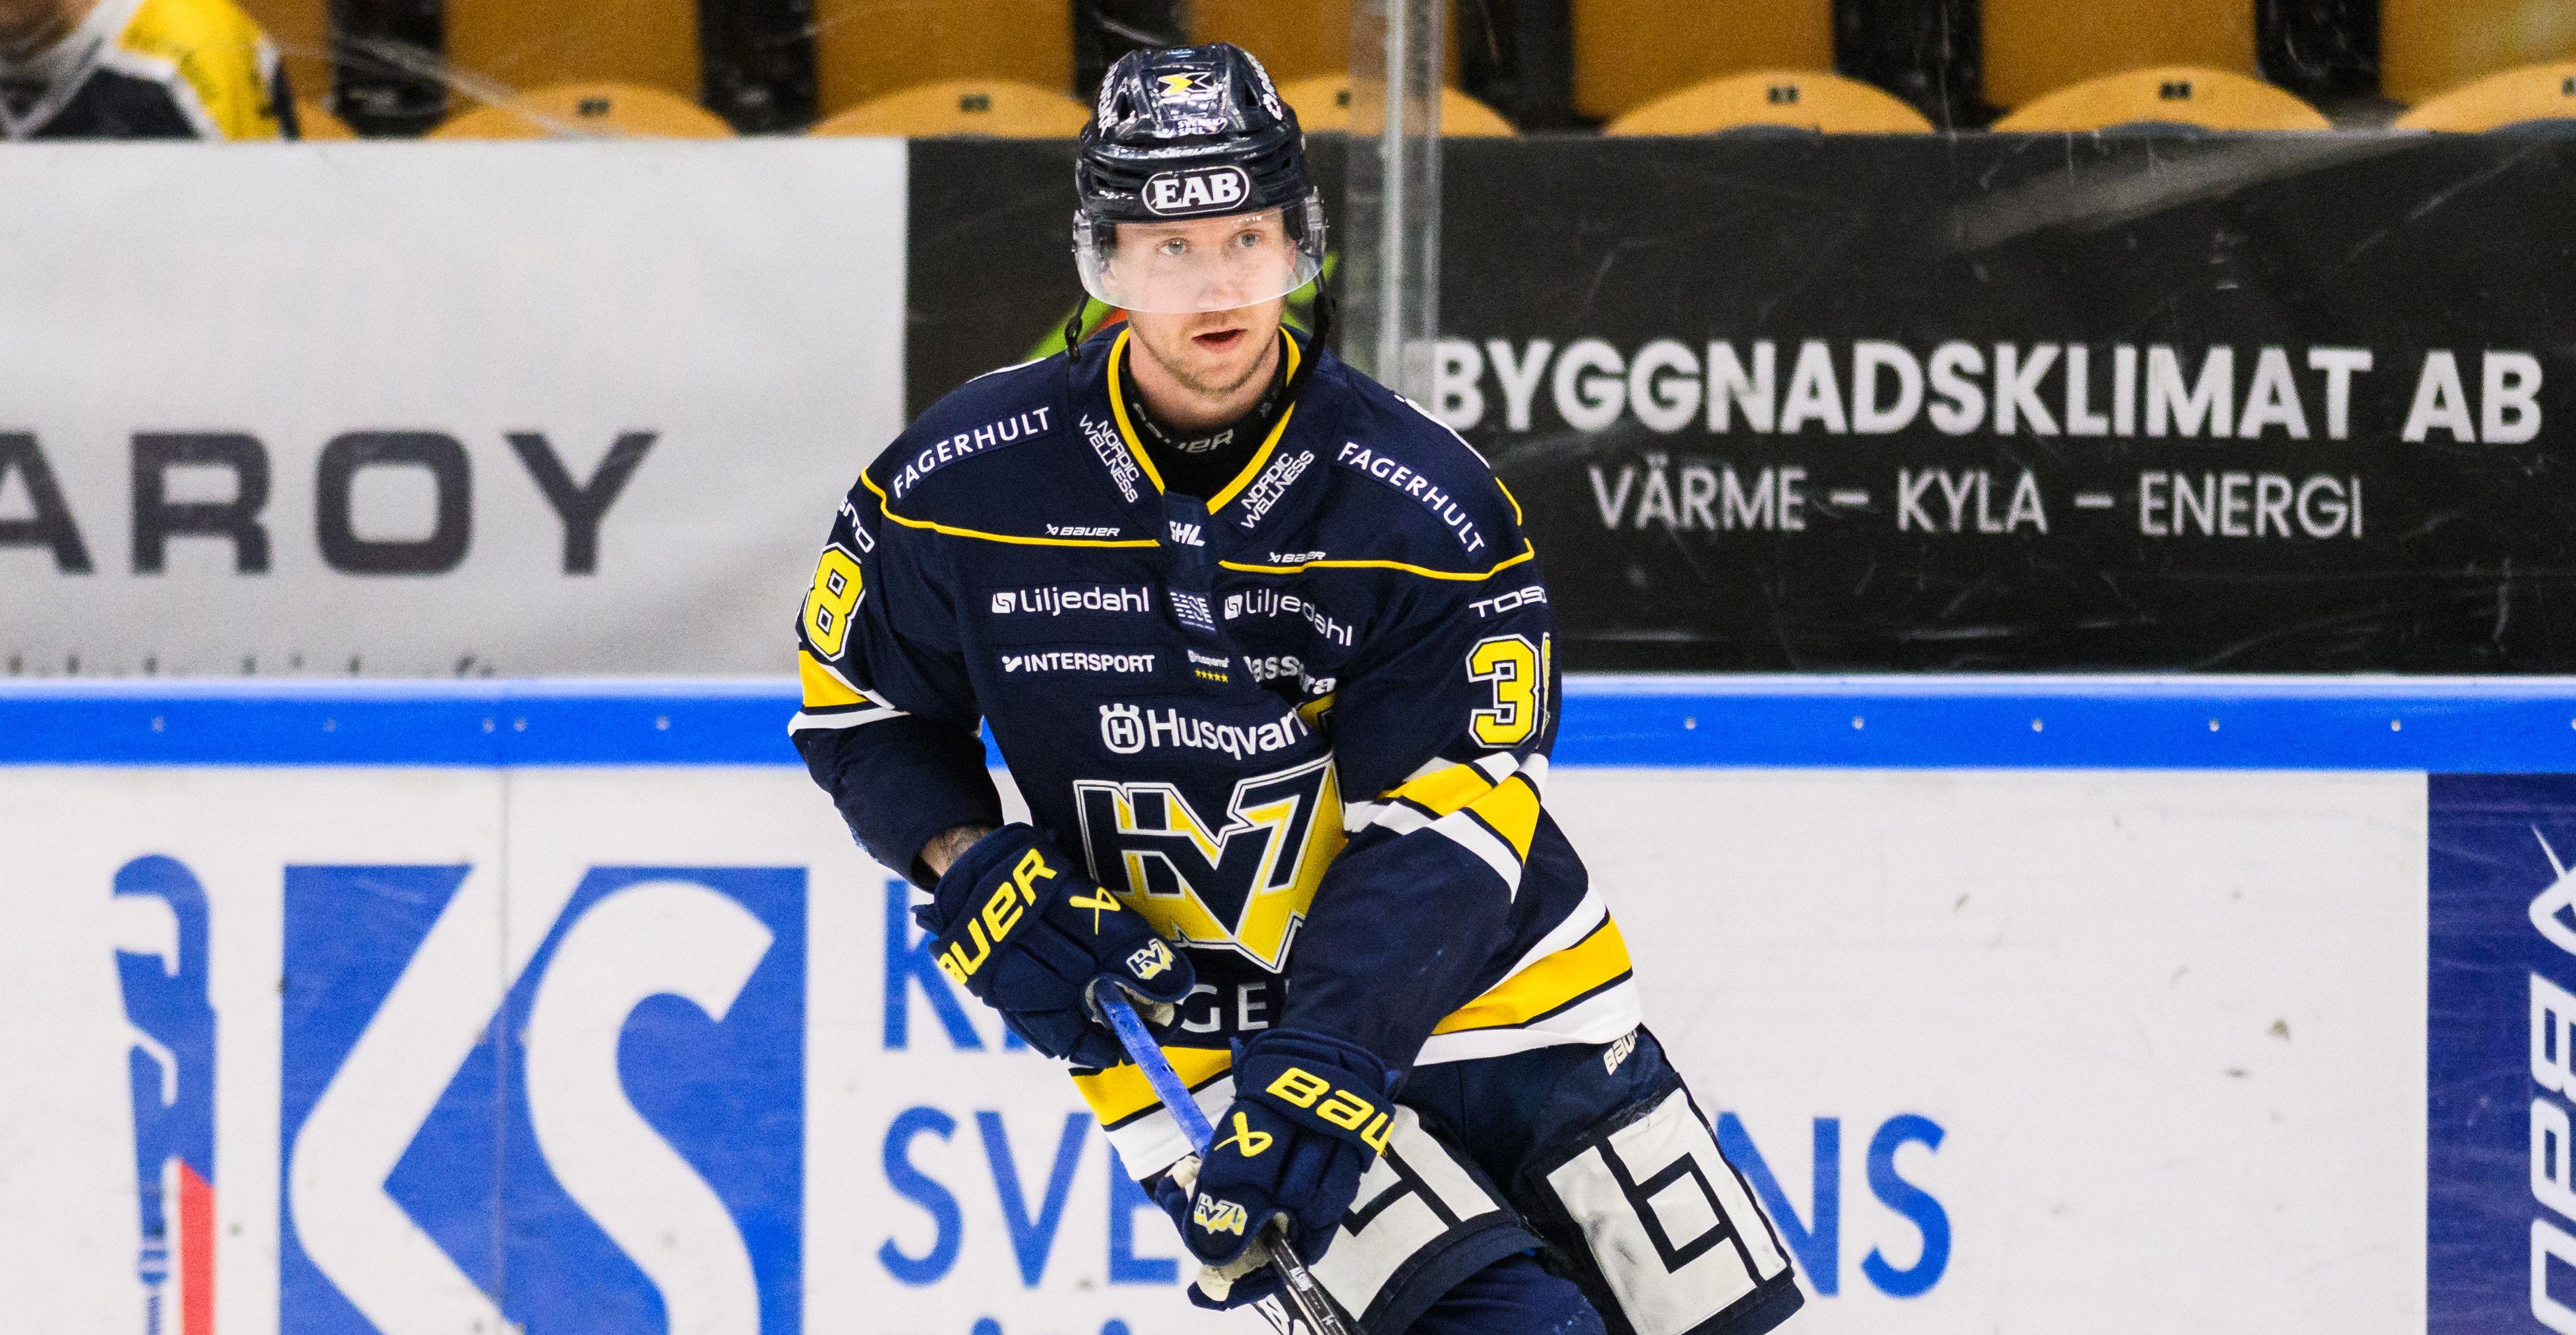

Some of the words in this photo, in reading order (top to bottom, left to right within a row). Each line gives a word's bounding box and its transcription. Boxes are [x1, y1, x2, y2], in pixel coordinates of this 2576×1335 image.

[1152, 173, 1241, 209] EAB
[1432, 339, 2373, 440] BYGGNADSKLIMAT
[2401, 348, 2544, 443] AB
[893, 406, 1049, 498] FAGERHULT
[1079, 414, 1138, 503] WELLNESS
[1097, 420, 1140, 482] NORDIC
[1241, 453, 1293, 510] NORDIC
[1241, 450, 1315, 528] WELLNESS
[1337, 442, 1485, 552] FAGERHULT
[1590, 454, 1806, 530] VÄRME
[1897, 468, 2049, 535] KYLA
[2139, 472, 2363, 539] ENERGI
[1281, 551, 1327, 563] BAER
[1020, 586, 1150, 617] Liljedahl
[1245, 588, 1353, 647] Liljedahl
[1023, 652, 1155, 672] INTERSPORT
